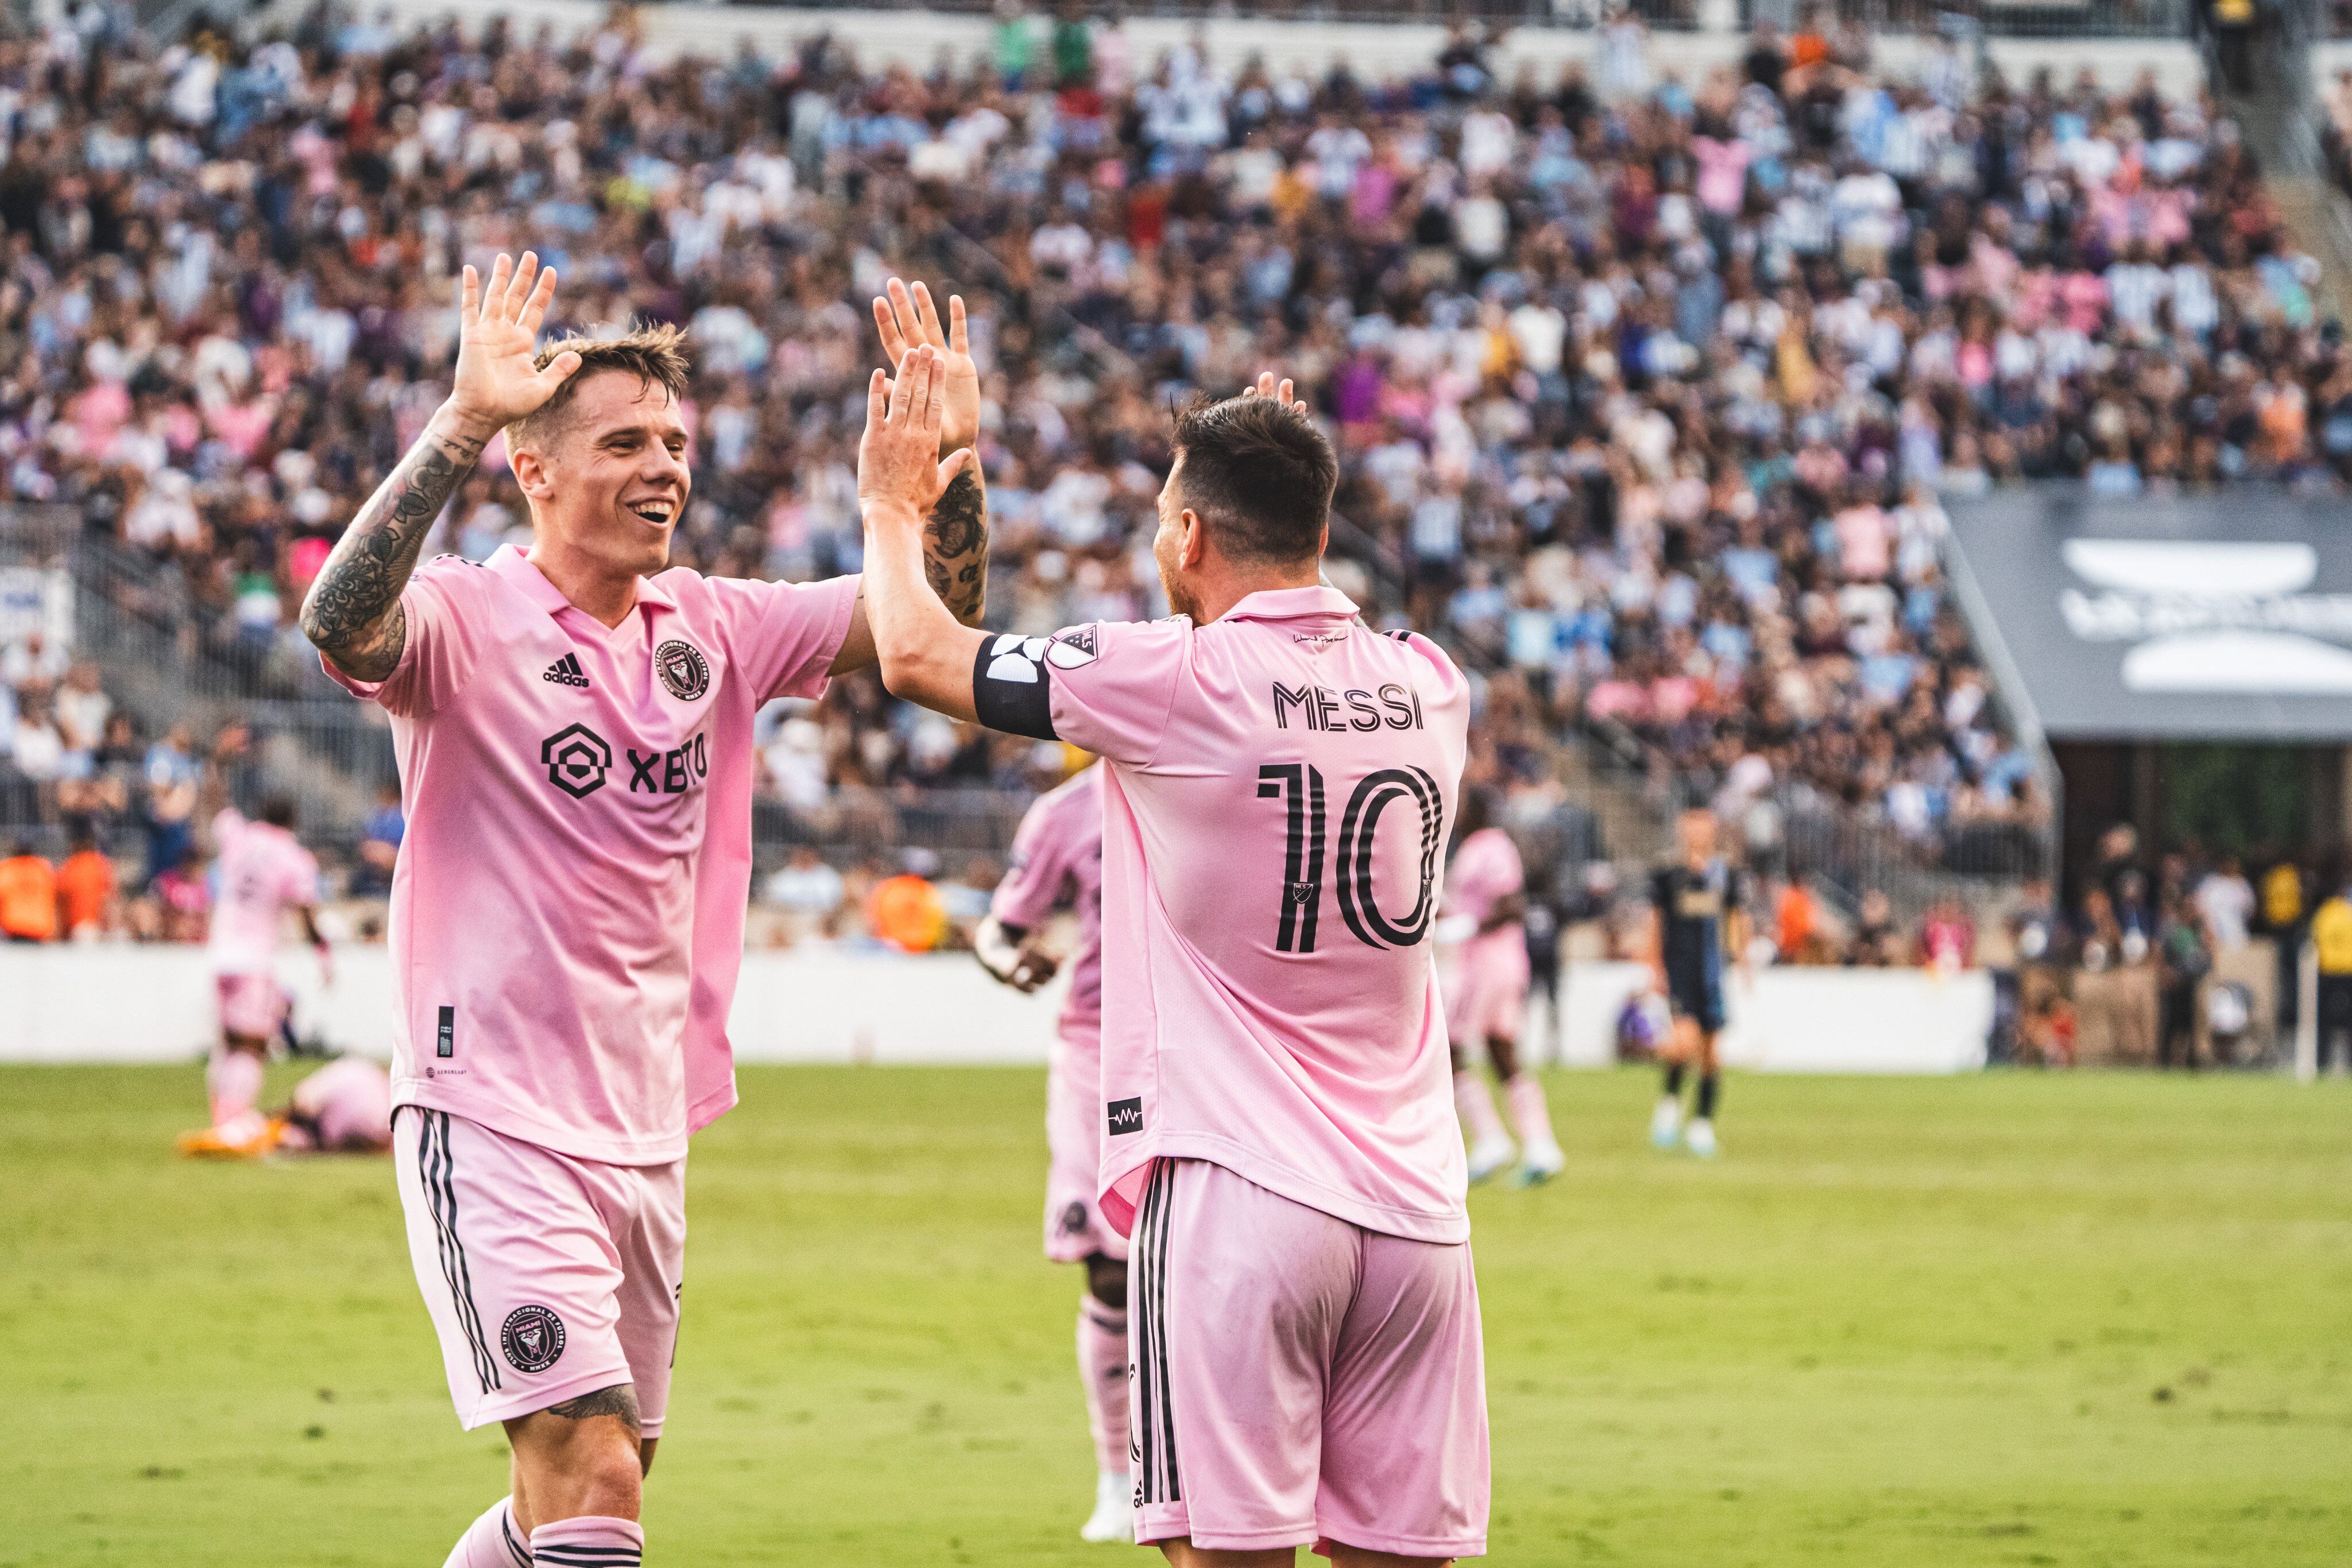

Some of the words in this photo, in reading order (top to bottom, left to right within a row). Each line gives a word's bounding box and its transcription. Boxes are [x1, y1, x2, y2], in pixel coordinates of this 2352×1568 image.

[1082, 630, 1092, 648] MLS
[665, 654, 685, 664] MIAMI
[543, 671, 589, 688] adidas
[1272, 682, 1423, 733] MESSI
[626, 731, 707, 793] XBTO
[1257, 763, 1443, 953] 10
[502, 1307, 546, 1345] INTERNACIONAL
[547, 1313, 556, 1321] DE
[515, 1320, 541, 1333] MIAMI
